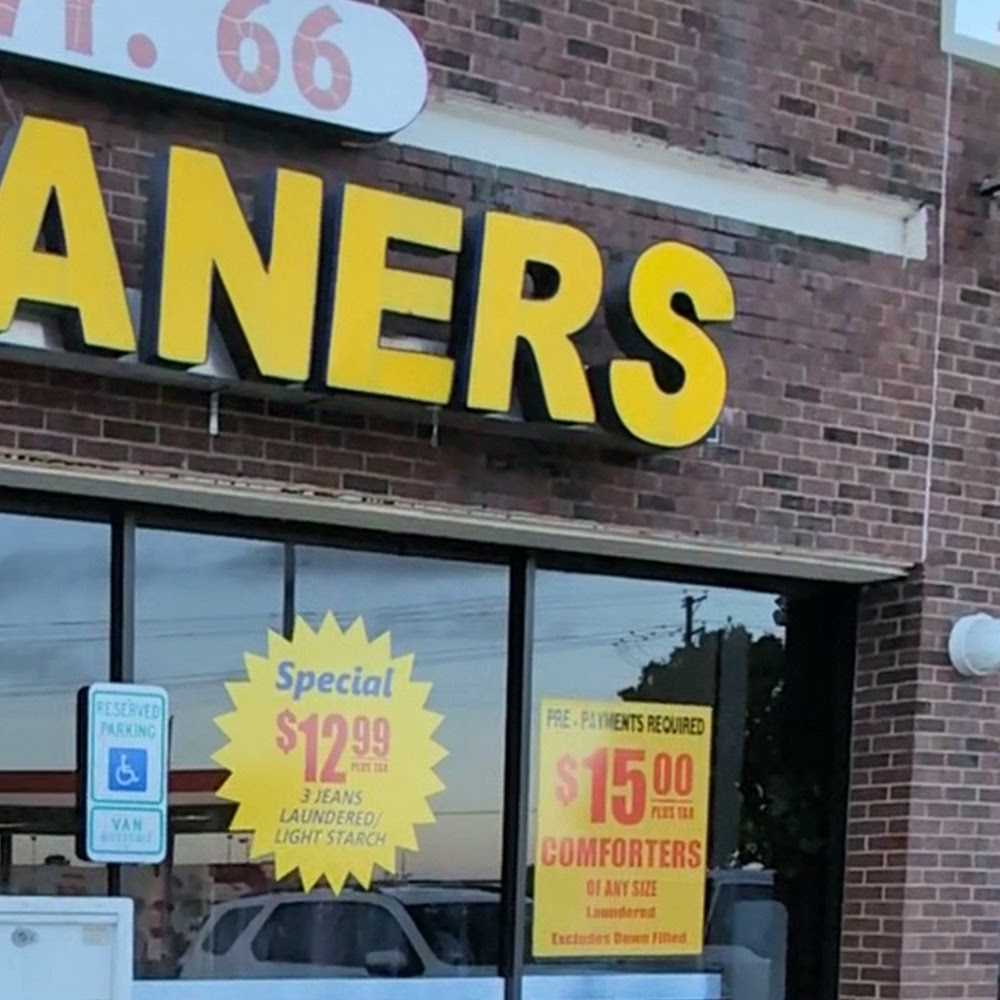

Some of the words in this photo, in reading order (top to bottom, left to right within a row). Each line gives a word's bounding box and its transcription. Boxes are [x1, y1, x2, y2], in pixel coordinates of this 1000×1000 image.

[216, 0, 352, 111] 66
[275, 660, 394, 701] Special
[96, 701, 161, 719] RESERVED
[101, 721, 157, 739] PARKING
[547, 709, 571, 728] PRE
[581, 710, 645, 733] PAYMENTS
[647, 714, 705, 736] REQUIRED
[300, 788, 310, 804] 3
[315, 789, 364, 806] JEANS
[112, 818, 143, 833] VAN
[279, 808, 384, 829] LAUNDERED/
[274, 828, 323, 845] LIGHT
[327, 829, 387, 847] STARCH
[541, 836, 701, 868] COMFORTERS
[586, 879, 601, 896] OF
[605, 880, 629, 896] ANY
[632, 880, 658, 897] SIZE
[586, 906, 656, 918] Laundered
[552, 932, 611, 945] Excludes
[614, 932, 649, 944] Down
[652, 931, 687, 944] Filled
